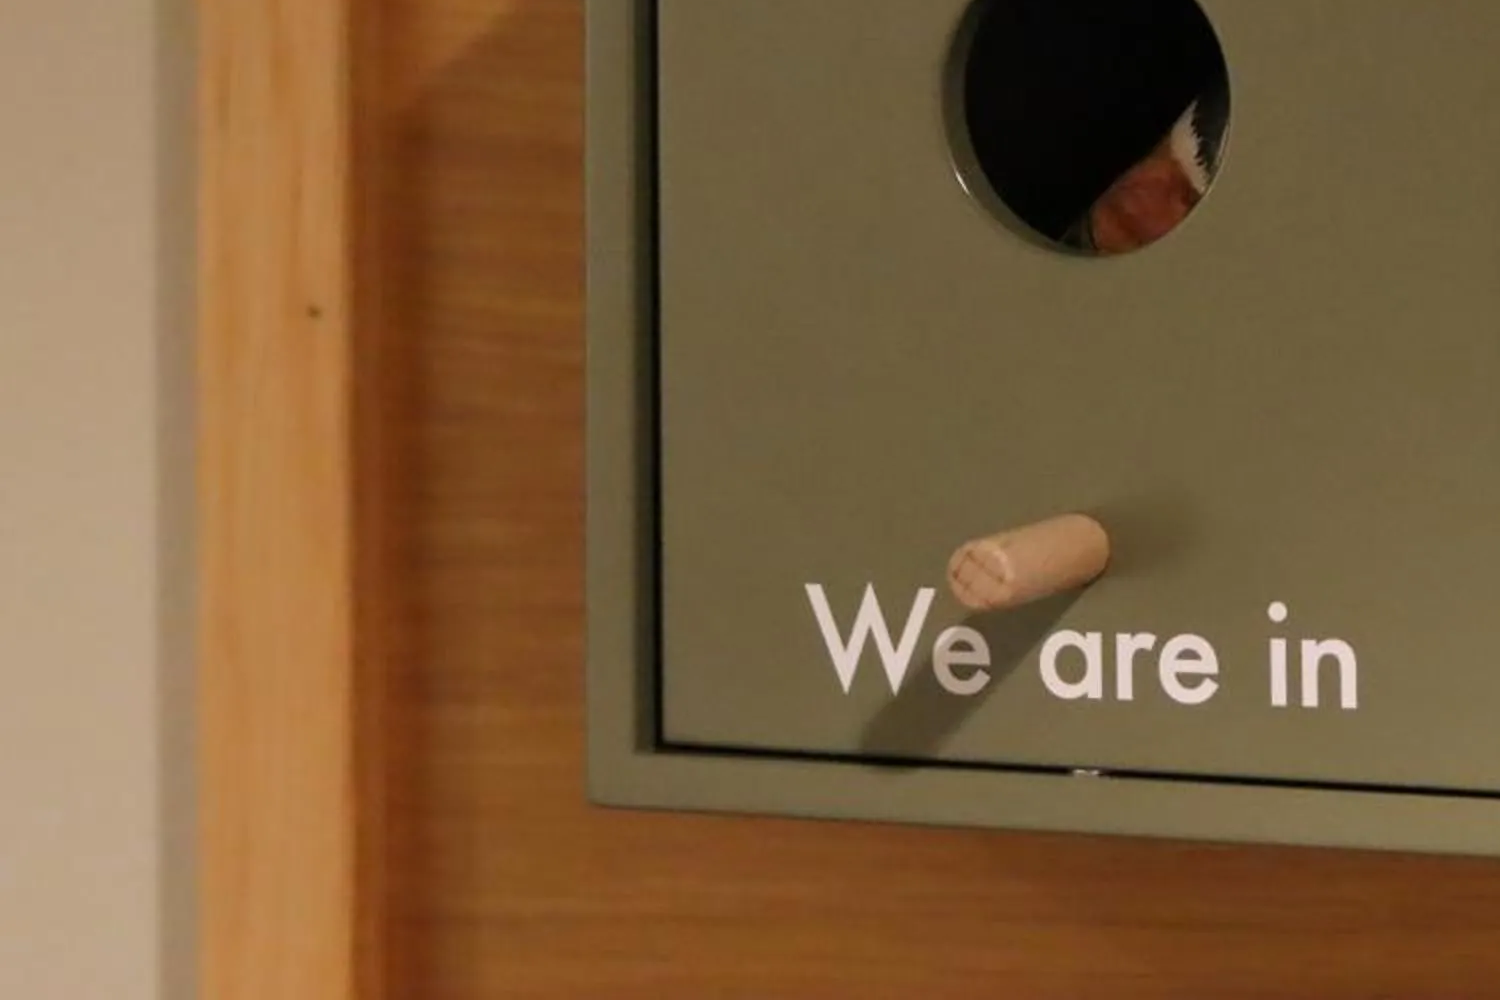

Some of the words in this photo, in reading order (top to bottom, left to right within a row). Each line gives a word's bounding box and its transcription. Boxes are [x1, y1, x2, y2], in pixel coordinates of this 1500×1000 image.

[803, 581, 992, 697] We
[1038, 628, 1220, 705] are
[1267, 600, 1359, 710] in
